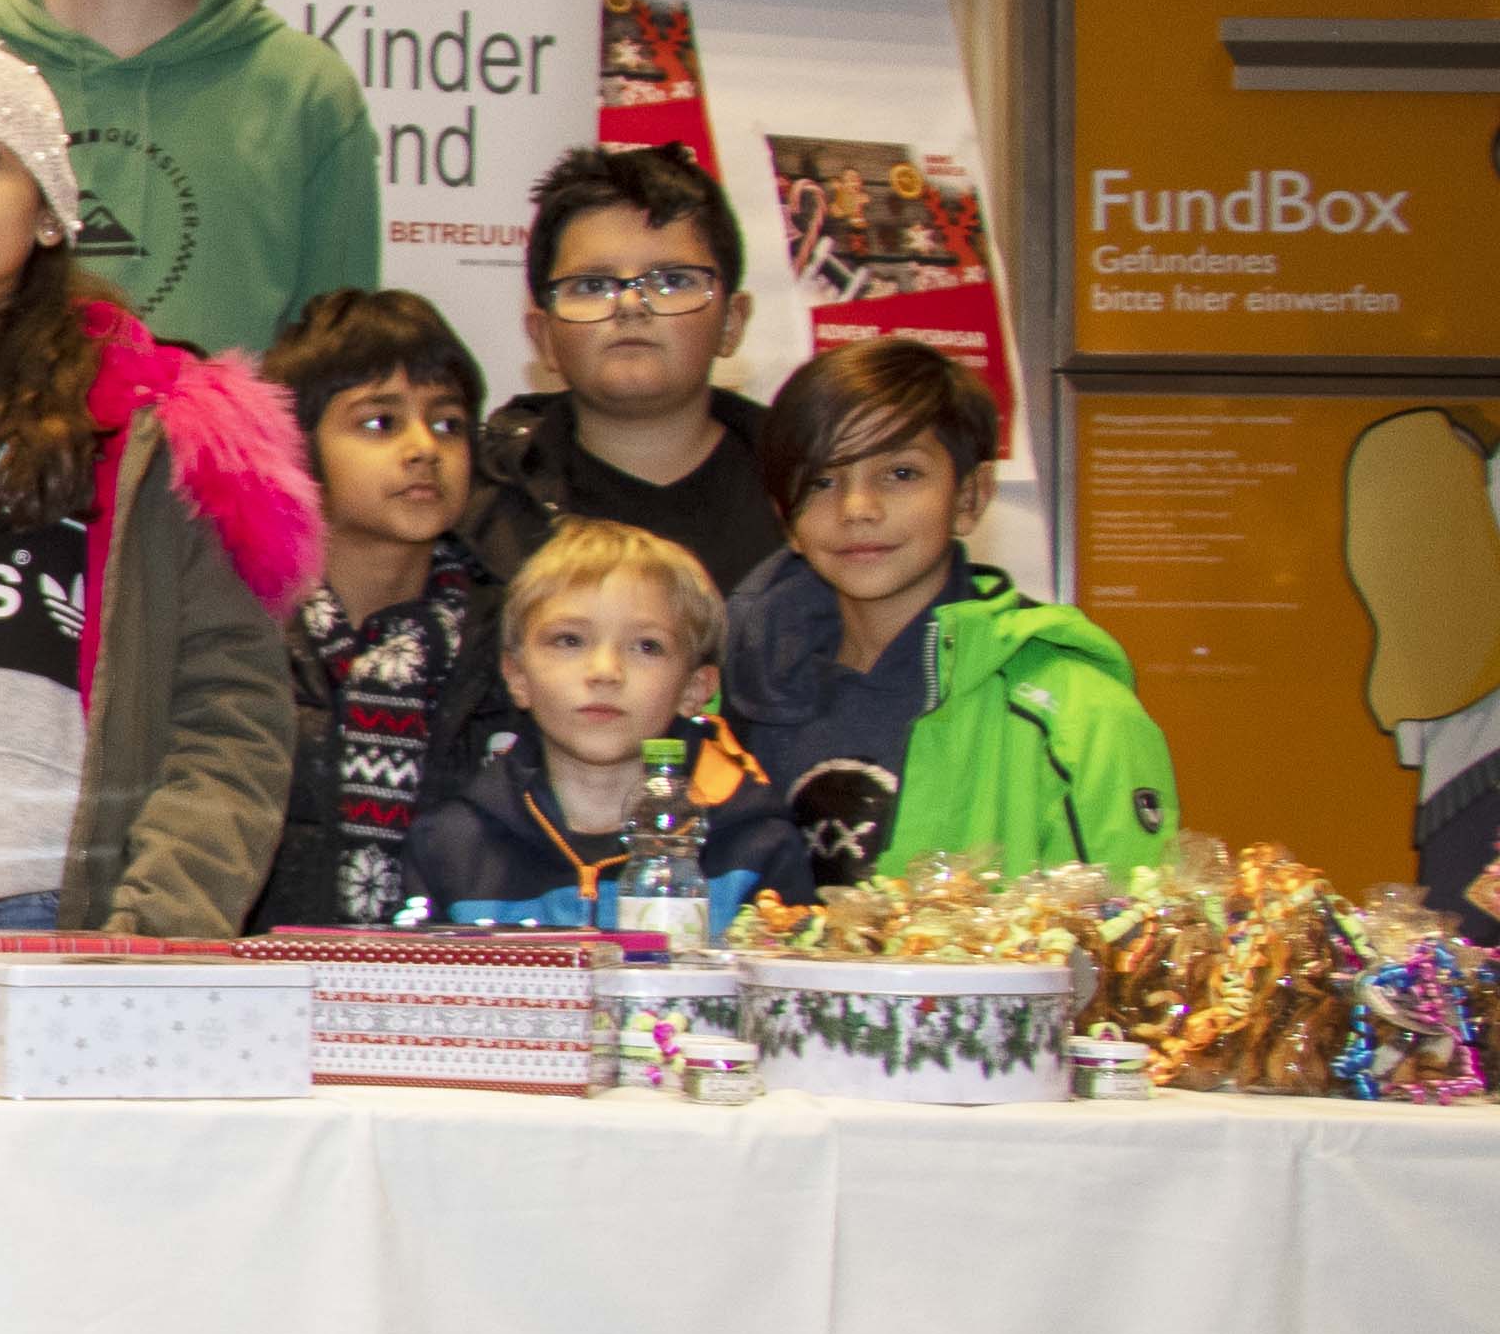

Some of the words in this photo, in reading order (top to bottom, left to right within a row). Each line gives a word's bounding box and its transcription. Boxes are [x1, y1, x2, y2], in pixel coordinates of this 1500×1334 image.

[304, 3, 557, 105] Kinder
[1091, 169, 1411, 233] FundBox
[389, 220, 531, 246] BETREUUN
[1092, 244, 1276, 274] Gefundenes
[1091, 283, 1164, 312] bitte
[1173, 283, 1235, 312] hier
[1245, 284, 1400, 312] einwerfen
